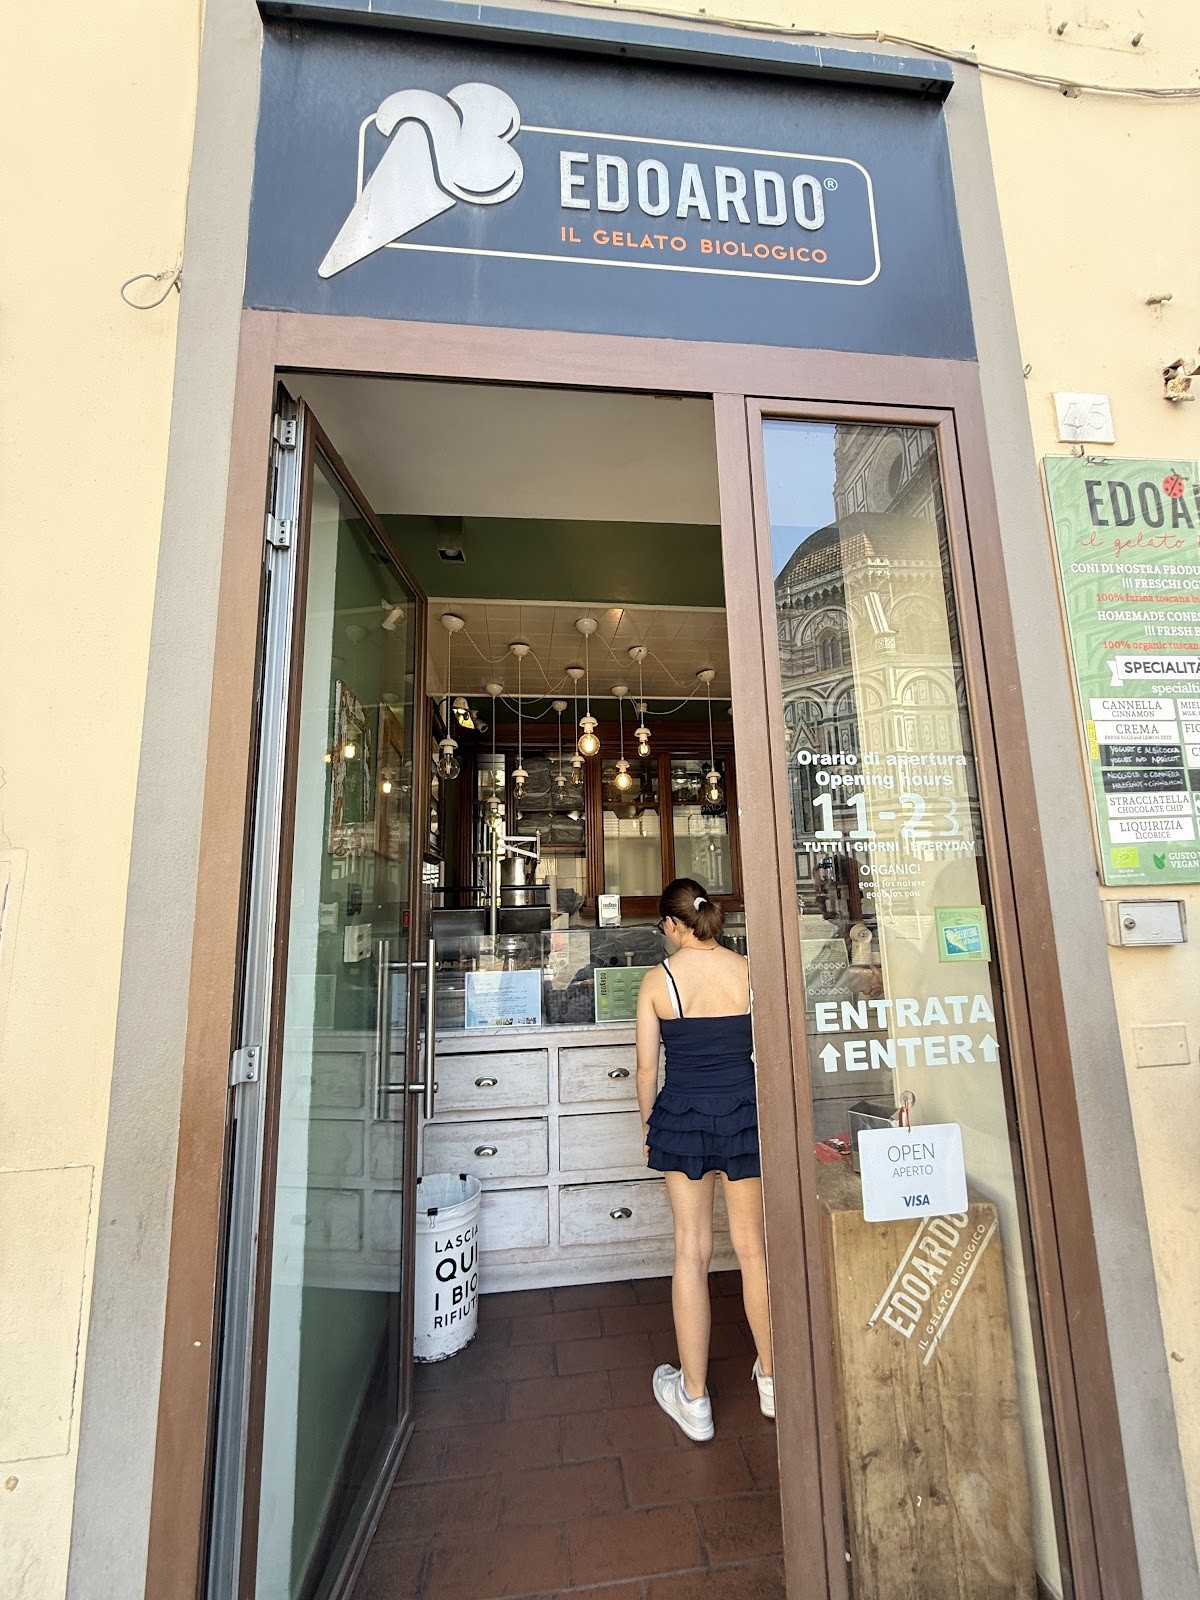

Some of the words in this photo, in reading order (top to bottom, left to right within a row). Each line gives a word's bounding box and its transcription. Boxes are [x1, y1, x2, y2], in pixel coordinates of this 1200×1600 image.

[561, 226, 581, 243] IL
[592, 229, 687, 252] GELATO
[700, 238, 828, 265] BIOLOGICO
[1114, 532, 1184, 558] gelato
[1071, 563, 1100, 573] CONI
[1101, 564, 1114, 573] DI
[1116, 564, 1161, 575] NOSTRA
[1134, 578, 1181, 588] FRESCHI
[1096, 593, 1124, 602] 100%
[1126, 593, 1153, 602] farina
[1156, 594, 1190, 602] toscana
[1097, 611, 1165, 621] HOMEMADE
[1156, 626, 1193, 636] FRESH
[1103, 641, 1130, 649] 100%
[1133, 642, 1167, 651] organic
[1102, 700, 1162, 710] CANNELLA
[1116, 723, 1159, 734] CREMA
[797, 750, 857, 766] Orario
[863, 751, 880, 766] di
[815, 770, 895, 789] Opening
[901, 773, 953, 787] hours
[1110, 794, 1190, 806] STRACCIATELLA
[1117, 806, 1165, 814] CHOCOLATE
[1165, 804, 1184, 812] CHIP
[1120, 820, 1184, 834] LIQUIRIZIA
[1135, 831, 1171, 839] LICORICE
[803, 842, 843, 852] TUTTI
[854, 841, 899, 852] GIORNI
[1168, 851, 1197, 860] GUSTO
[860, 864, 921, 875] ORGANIC!
[1170, 860, 1199, 869] VEGAN
[859, 881, 880, 889] good
[815, 994, 995, 1032] ENTRATA
[843, 1034, 976, 1071] ENTER
[887, 1142, 935, 1163] OPEN
[892, 1164, 934, 1179] APERTO
[902, 1194, 931, 1207] VISA
[435, 1224, 478, 1253] LASCIA
[435, 1241, 478, 1282] QUI
[452, 1272, 478, 1306] BIO
[918, 1339, 929, 1351] IL
[926, 1289, 953, 1335] GELATO
[950, 1224, 986, 1286] BIOLOGICO
